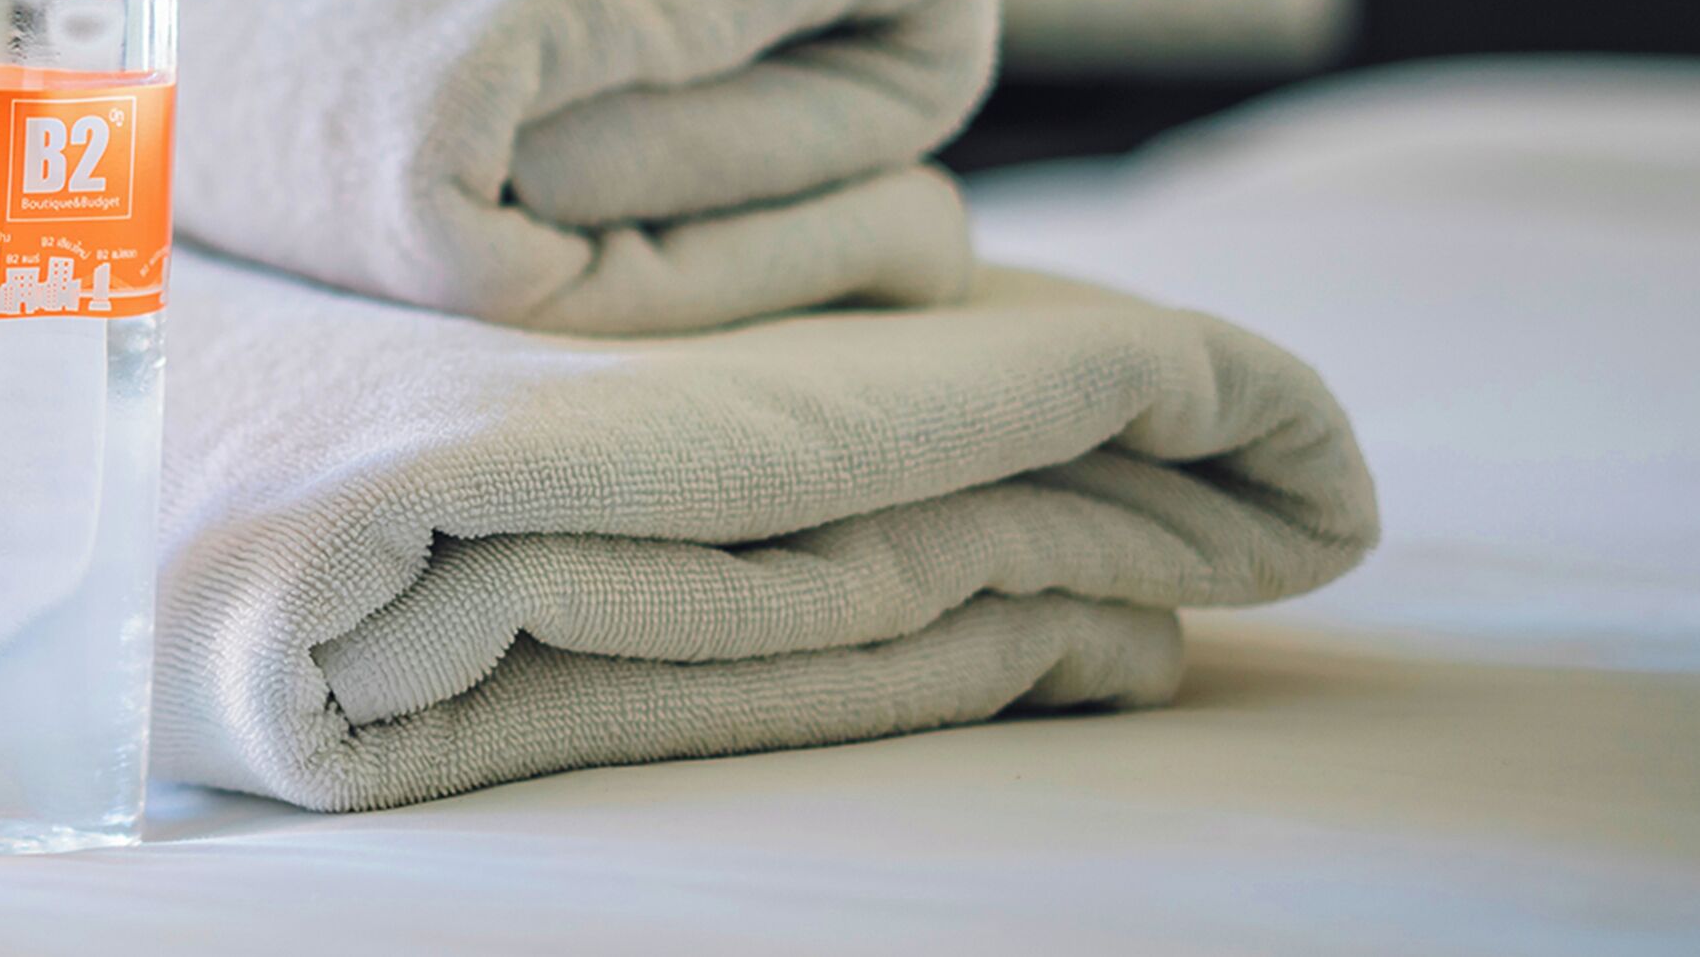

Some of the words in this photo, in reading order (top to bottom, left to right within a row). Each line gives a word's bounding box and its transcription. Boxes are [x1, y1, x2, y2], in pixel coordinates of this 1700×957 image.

[23, 115, 110, 194] B2
[20, 196, 120, 213] Boutique&Budget
[41, 236, 55, 248] B2
[6, 253, 20, 265] B2
[96, 249, 109, 261] B2
